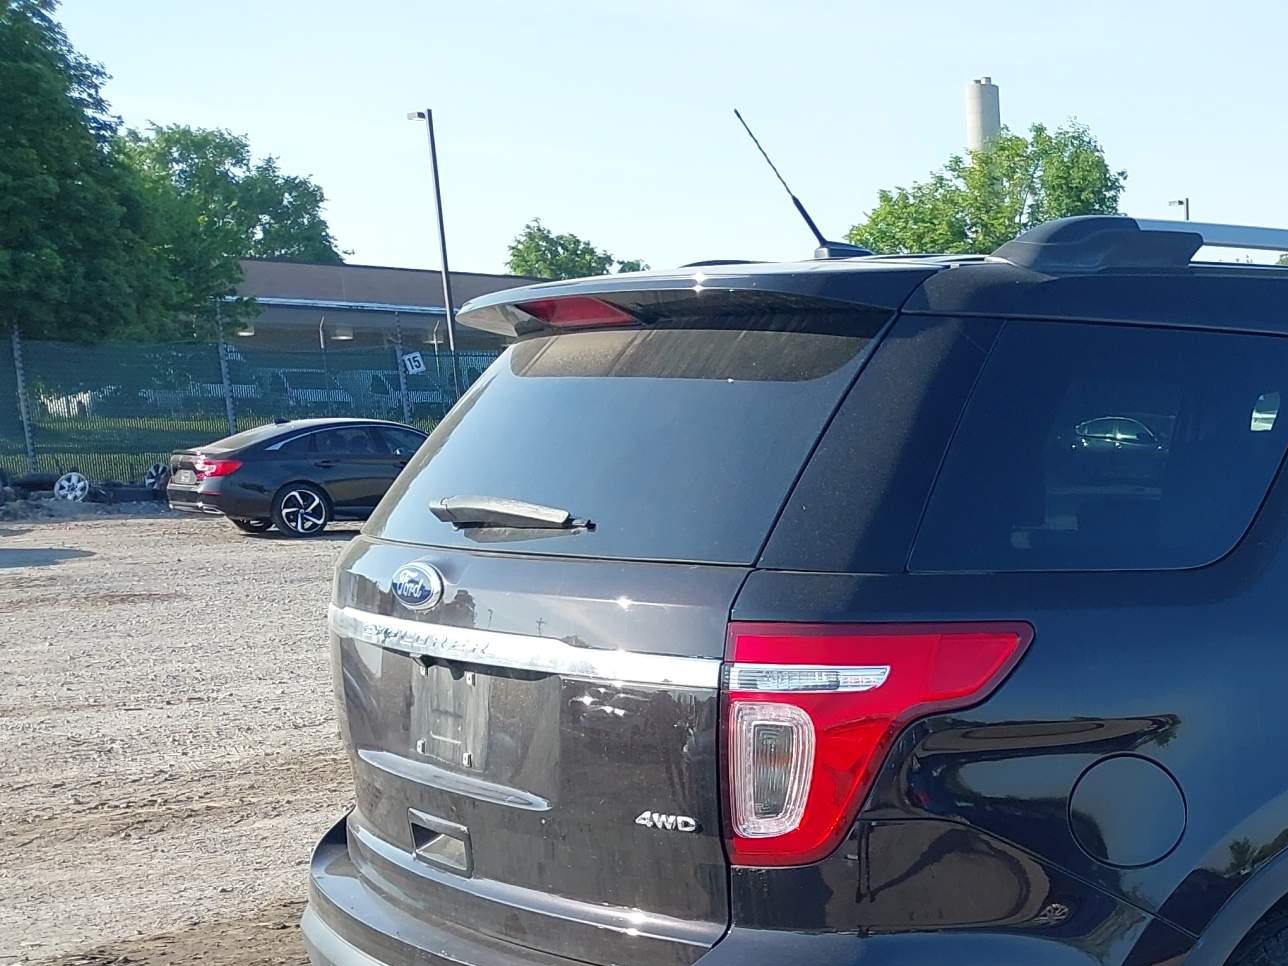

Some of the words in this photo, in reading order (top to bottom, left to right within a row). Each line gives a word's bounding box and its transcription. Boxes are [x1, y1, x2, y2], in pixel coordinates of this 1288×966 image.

[407, 356, 421, 370] 15
[394, 570, 425, 598] Ford
[635, 810, 697, 832] 4WD
